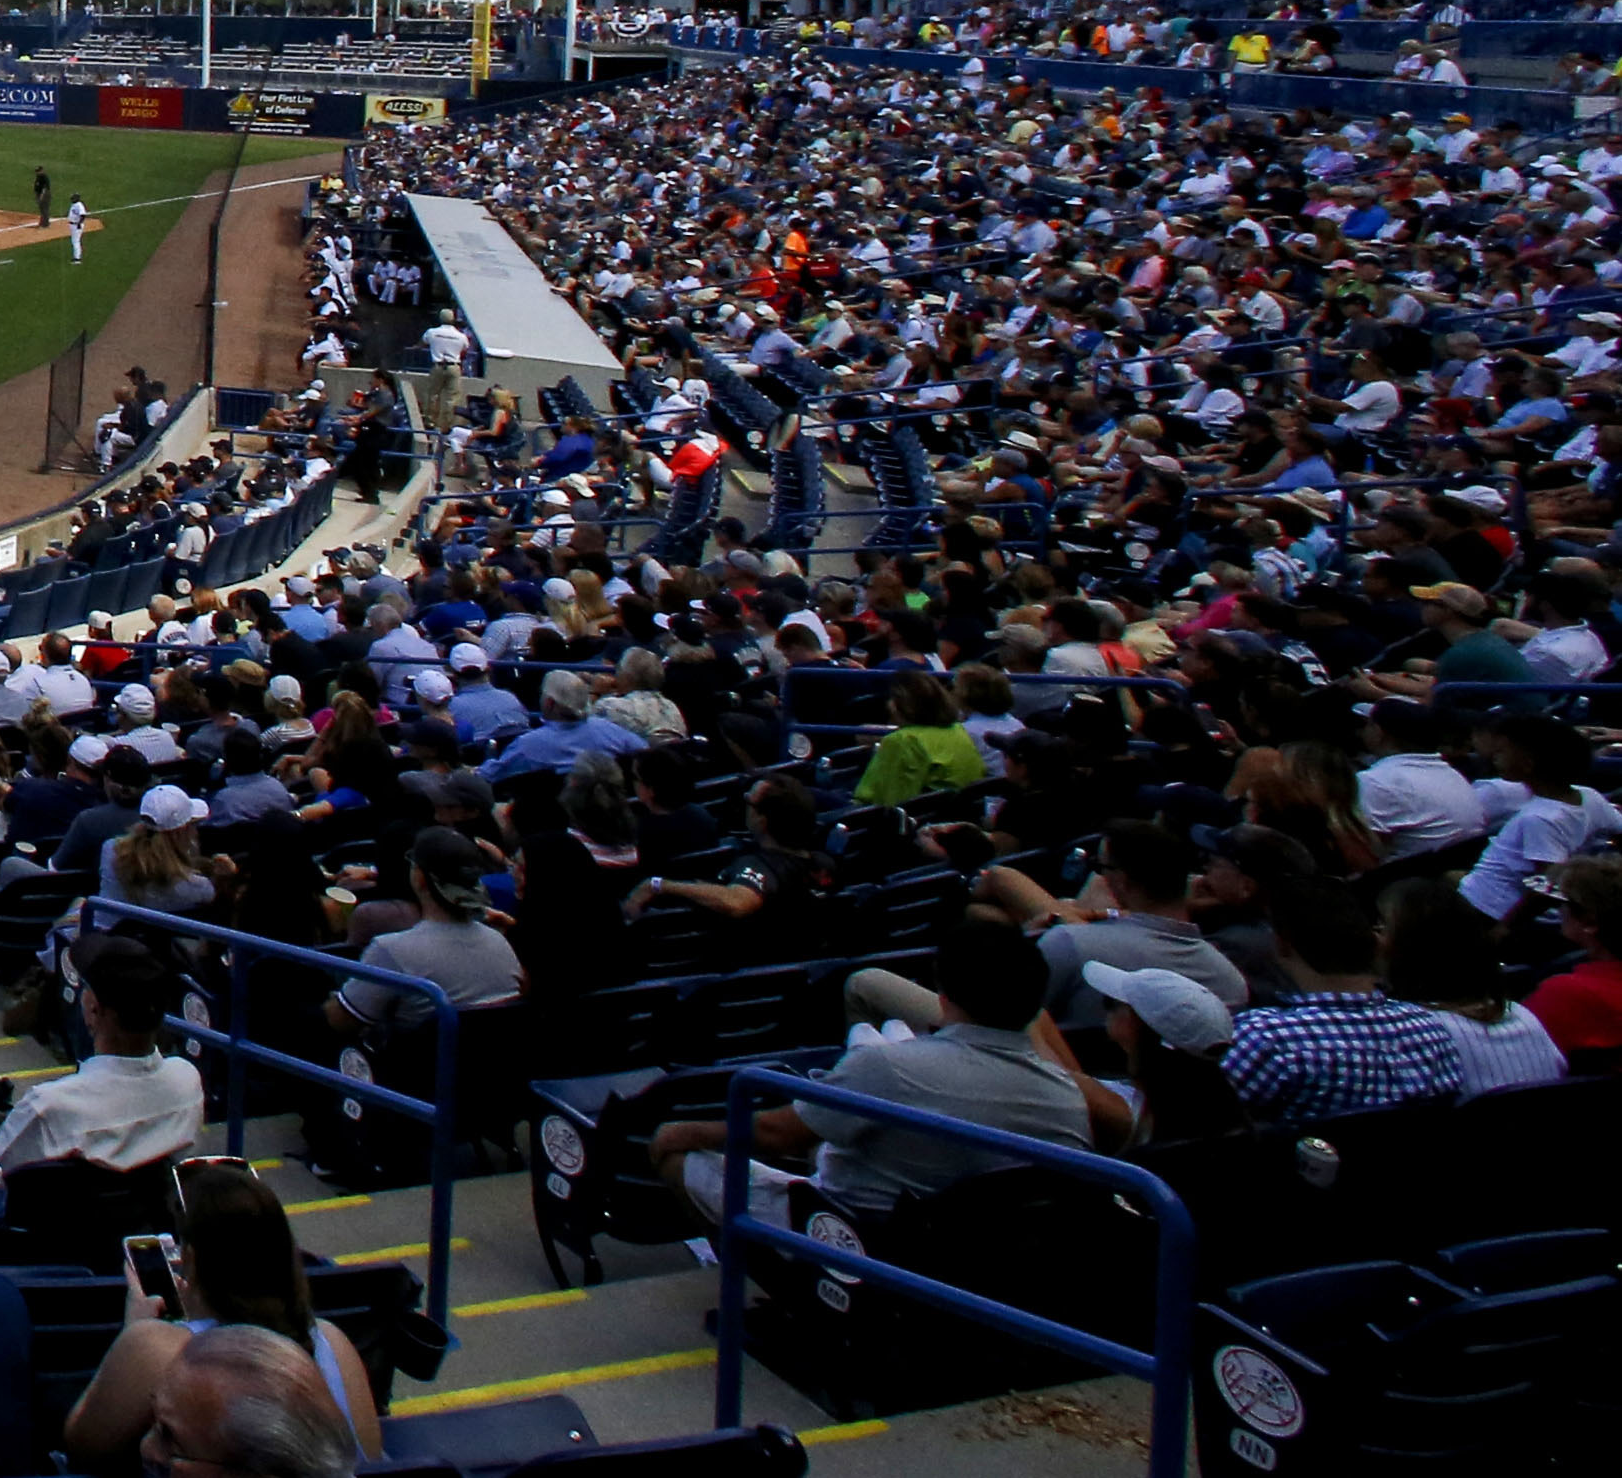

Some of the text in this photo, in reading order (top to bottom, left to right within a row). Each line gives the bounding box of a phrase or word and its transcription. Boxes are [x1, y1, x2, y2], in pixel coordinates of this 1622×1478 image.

[120, 97, 159, 107] WELLS
[259, 94, 277, 103] Your
[278, 95, 296, 103] First
[121, 109, 159, 118] FARGO
[1238, 1434, 1268, 1465] NN
